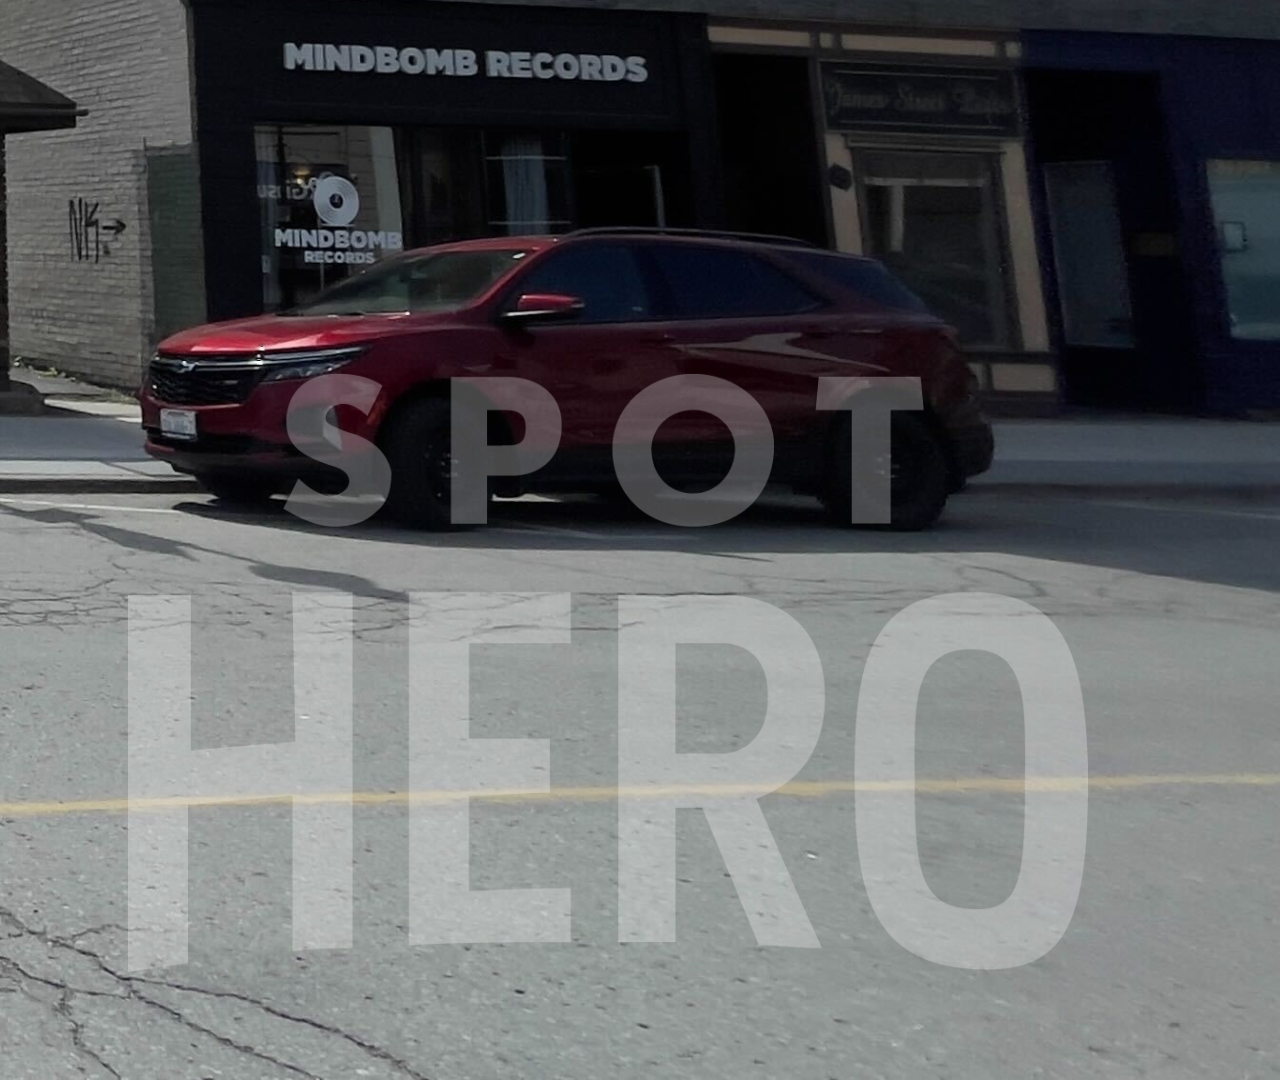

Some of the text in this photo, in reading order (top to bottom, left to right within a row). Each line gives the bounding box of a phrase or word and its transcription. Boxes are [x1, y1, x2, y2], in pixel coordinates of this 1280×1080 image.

[283, 42, 648, 82] MINDBOMB RECORDS
[274, 228, 402, 249] MINDBOMB
[304, 250, 375, 264] RECORDS
